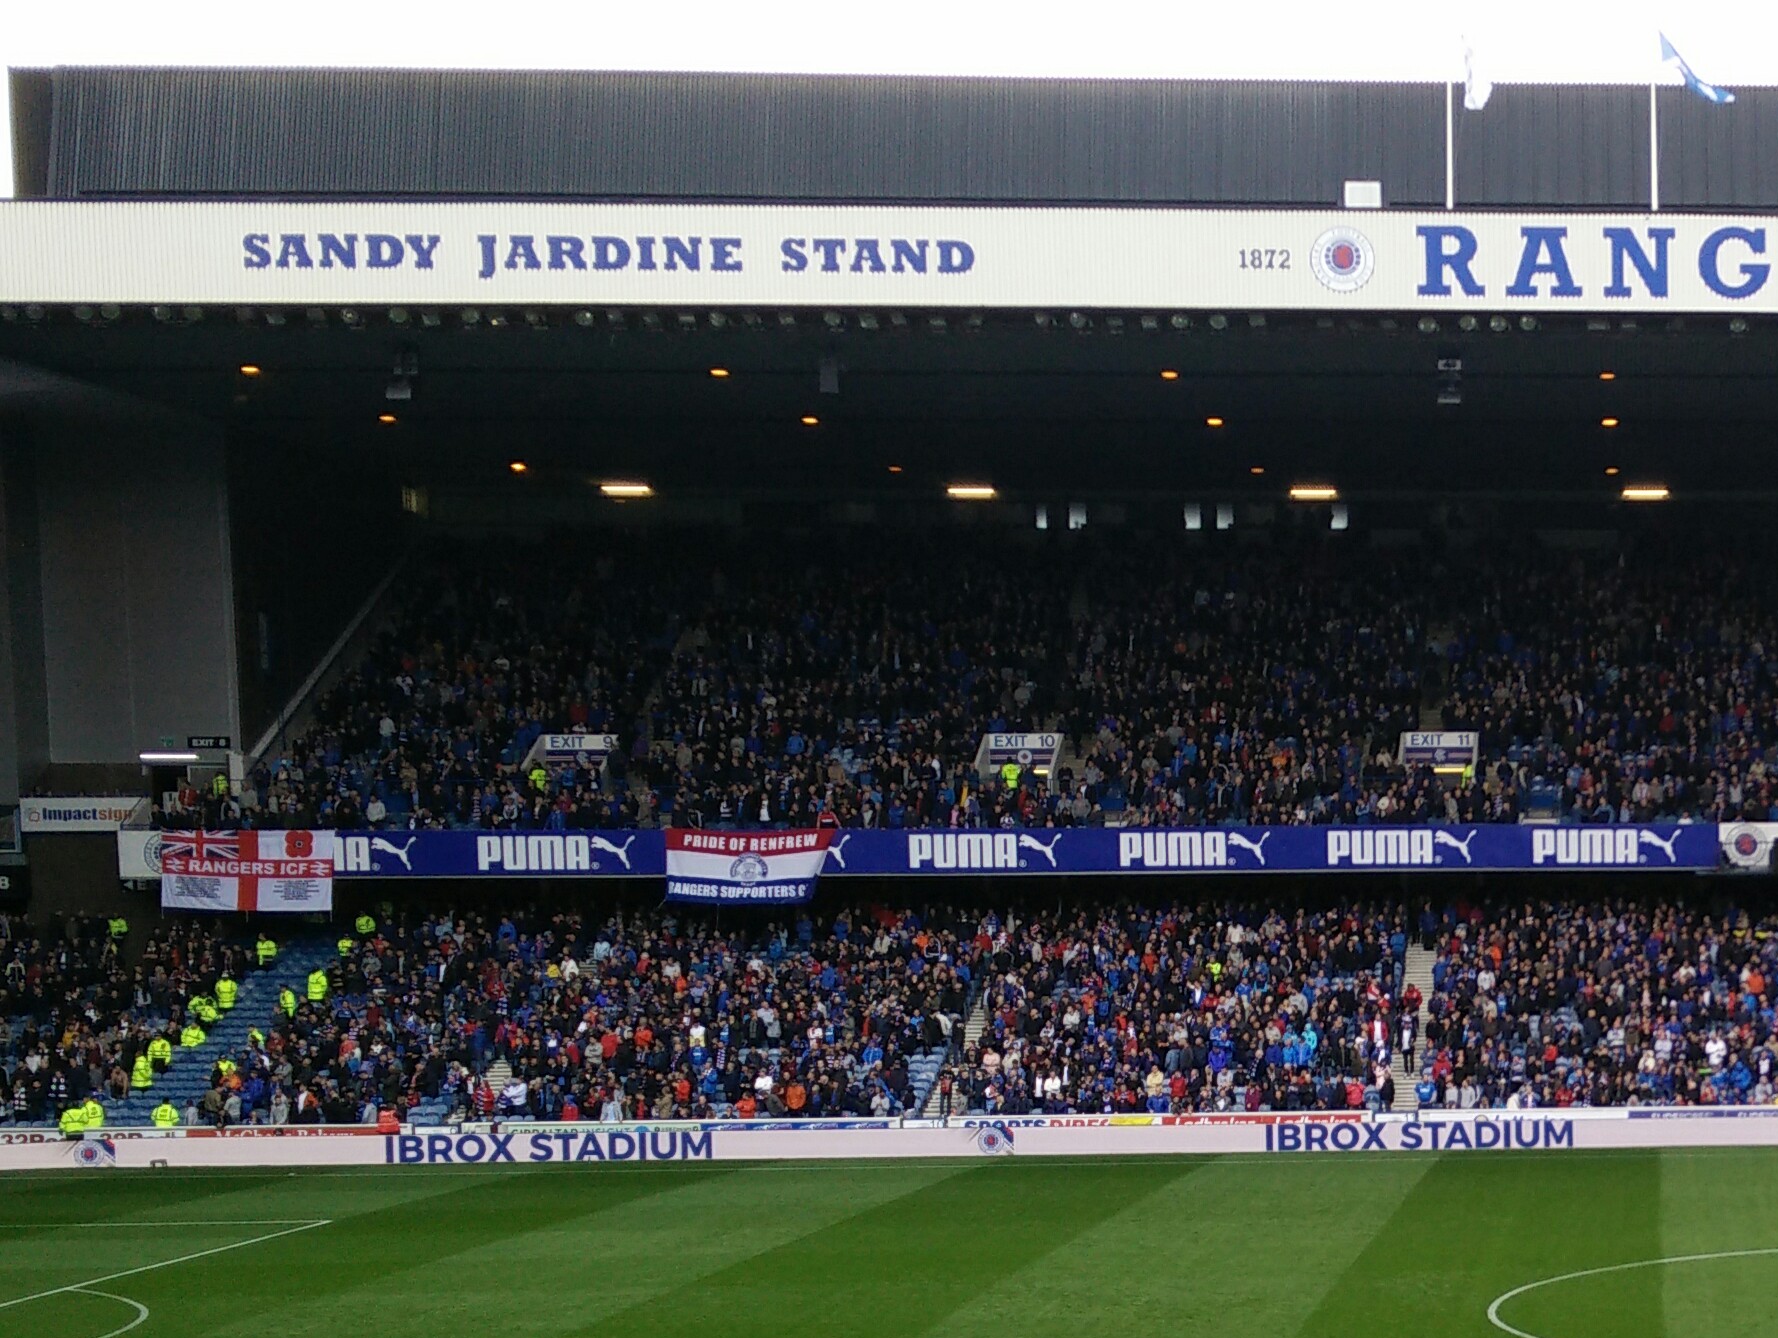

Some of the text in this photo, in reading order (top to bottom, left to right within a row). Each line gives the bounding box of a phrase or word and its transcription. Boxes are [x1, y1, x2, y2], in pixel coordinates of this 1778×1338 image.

[242, 233, 976, 279] SANDY JARDINE STAND
[1237, 249, 1290, 272] 1872
[191, 738, 214, 747] EXIT
[551, 735, 614, 748] EXIT 9
[994, 735, 1056, 747] EXIT 10
[1410, 734, 1470, 746] EXIT 11
[42, 807, 134, 822] impactsign
[478, 836, 589, 870] PUMA
[909, 834, 1017, 869] PUMA
[1120, 832, 1226, 866] PUMA
[1328, 830, 1433, 865] PUMA
[1533, 830, 1638, 864] PUMA
[683, 833, 818, 851] PRIDE OF RENFREW
[188, 859, 308, 876] RANGERS ICF
[668, 882, 718, 897] RANGERS
[720, 884, 796, 898] SUPPORTERS
[1266, 1120, 1573, 1151] IBROX STADIUM
[386, 1132, 713, 1163] IBROX STADIUM
